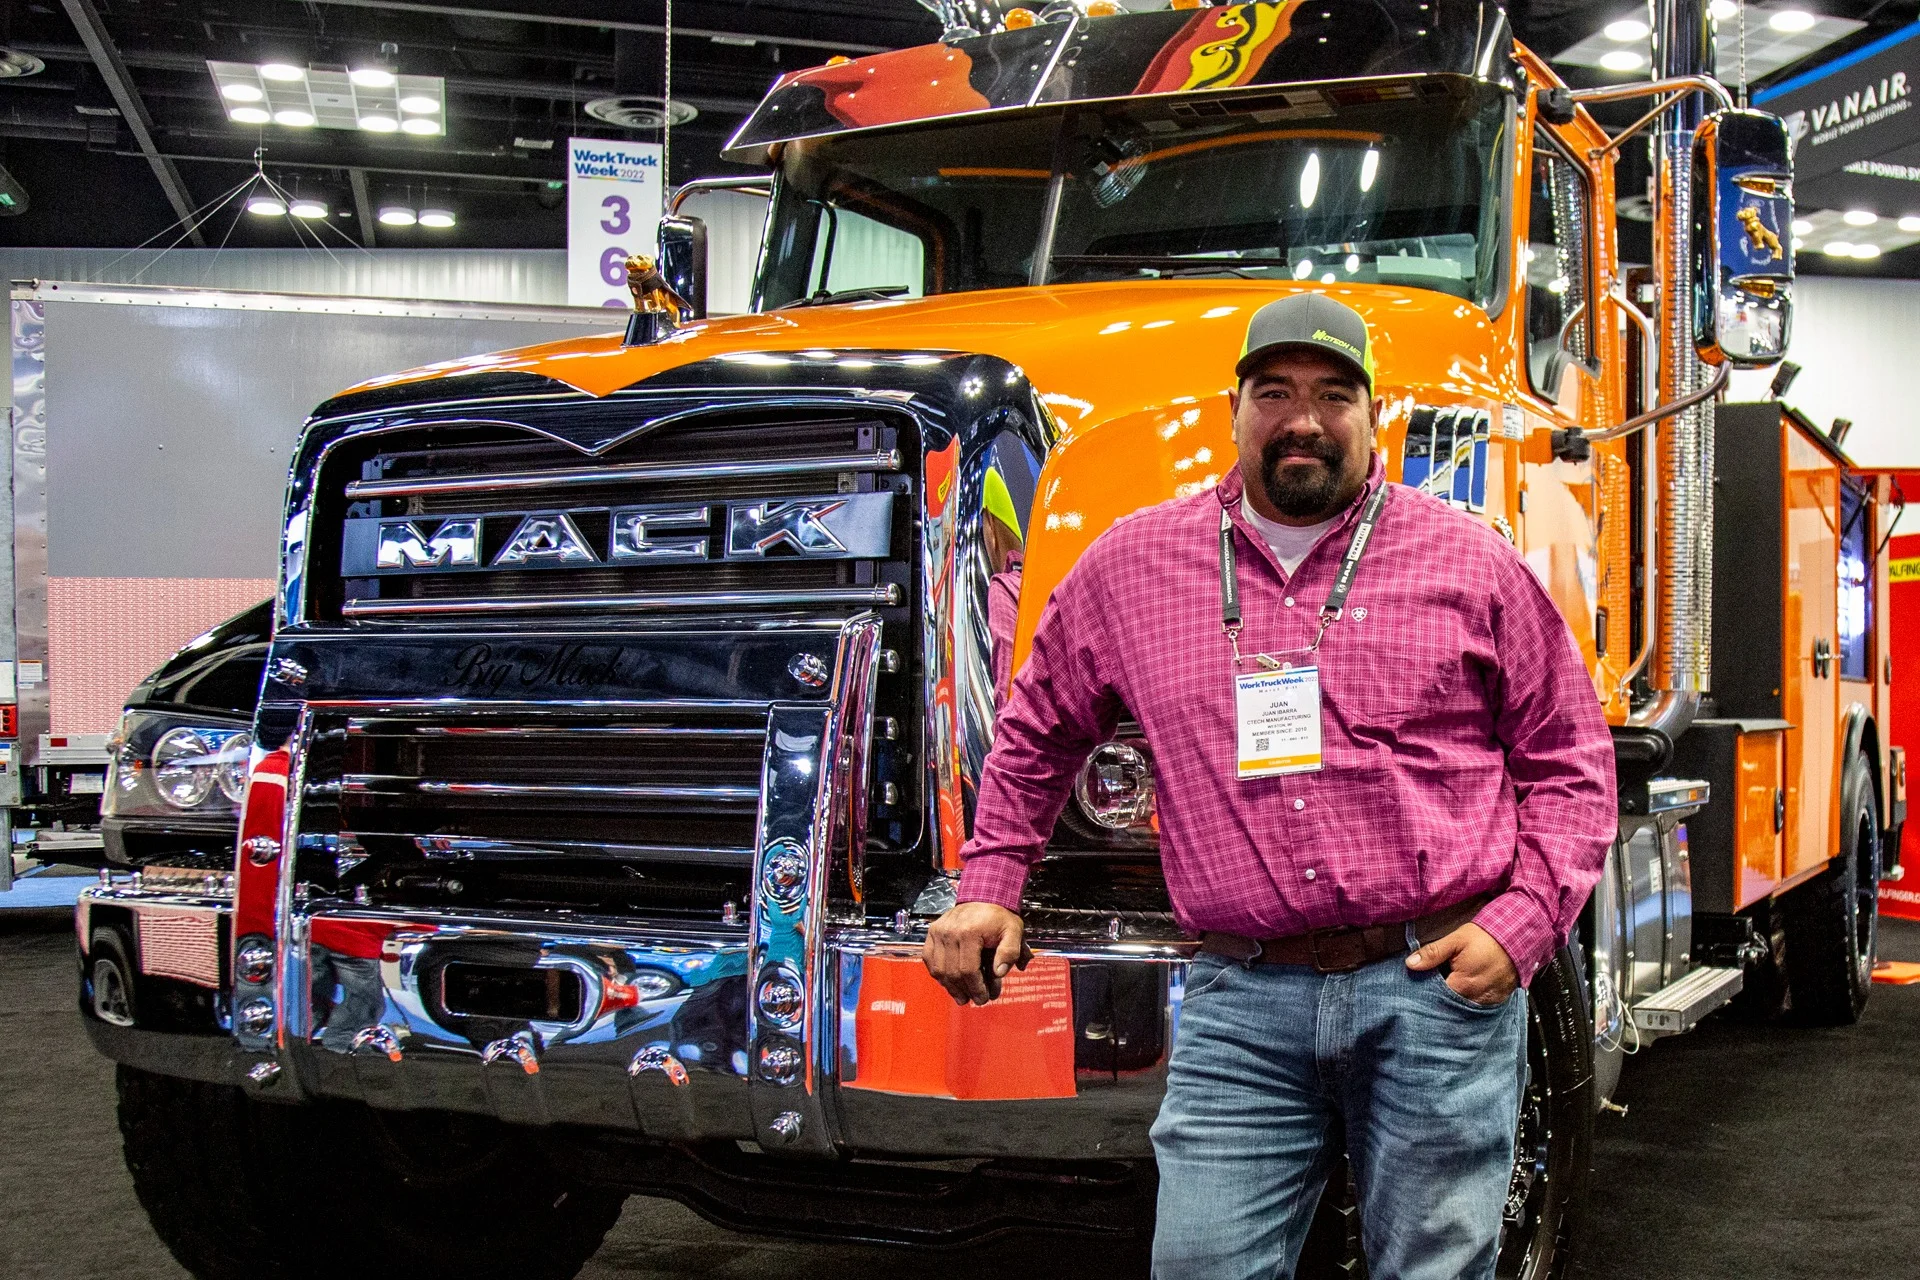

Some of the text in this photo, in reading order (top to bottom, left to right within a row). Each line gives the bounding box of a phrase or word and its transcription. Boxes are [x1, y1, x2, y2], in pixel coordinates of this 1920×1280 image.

[1810, 71, 1907, 132] VANAIR
[1838, 116, 1865, 136] POWER
[1864, 98, 1907, 126] SOLUTIONS
[574, 162, 645, 179] Week 2022
[1870, 160, 1907, 179] POWER
[600, 195, 631, 235] 3
[599, 247, 629, 287] 6
[376, 500, 849, 568] MACK
[1341, 524, 1369, 584] RAM COMMERCIAL
[443, 641, 625, 696] Big Mack
[1265, 713, 1311, 723] MANUFACTURING
